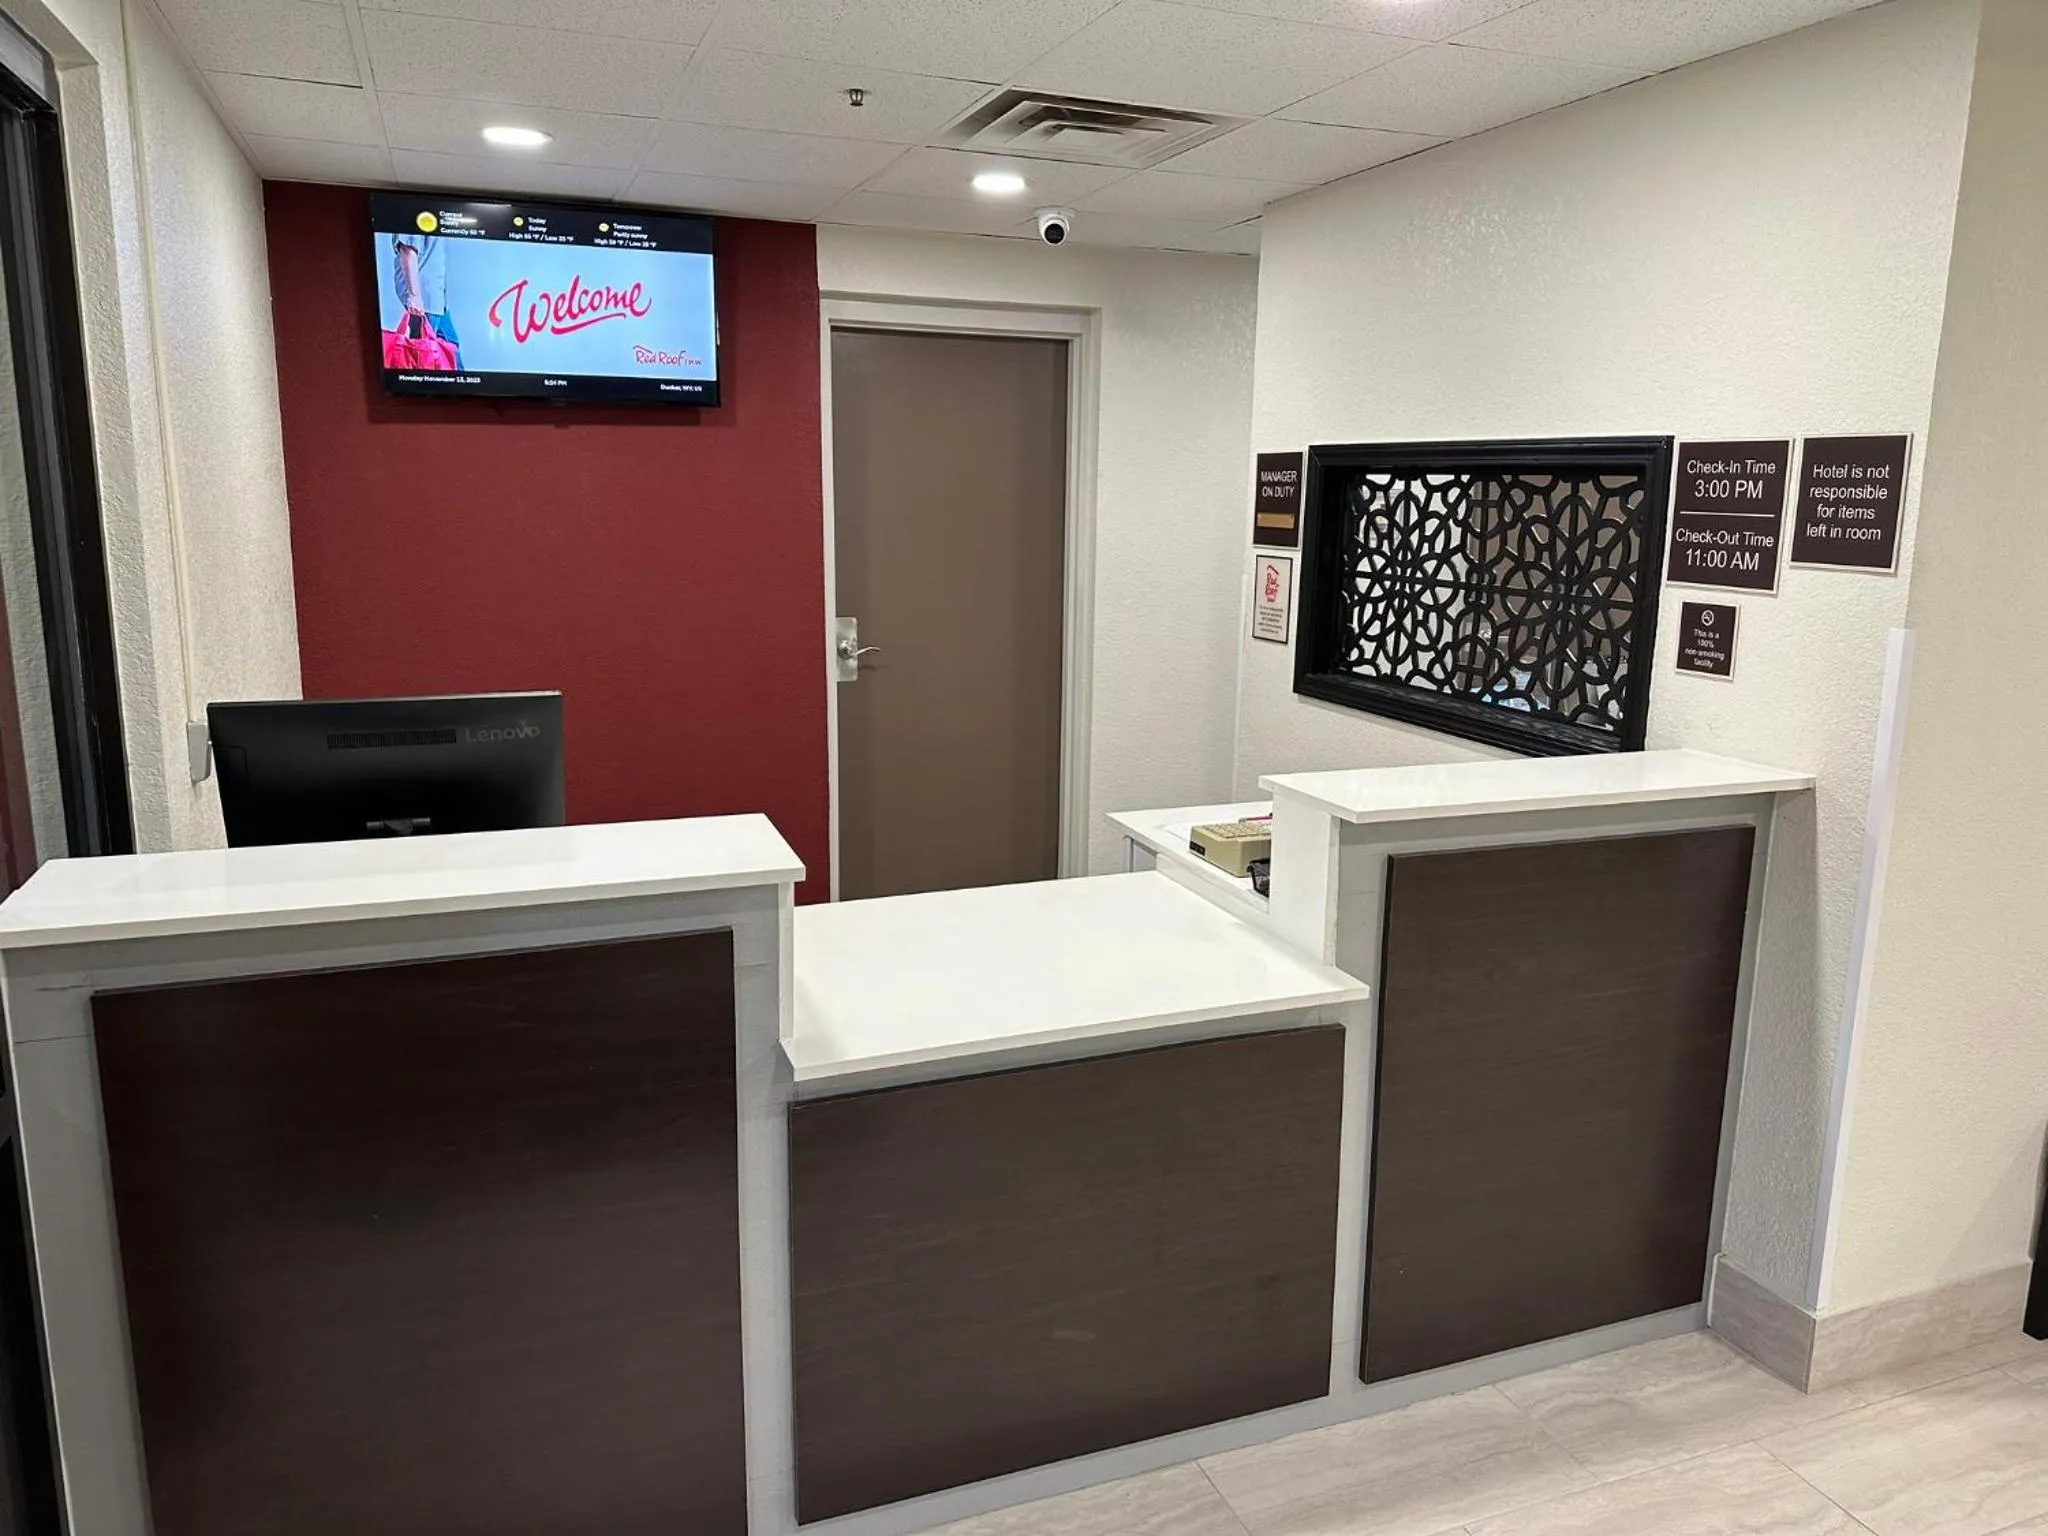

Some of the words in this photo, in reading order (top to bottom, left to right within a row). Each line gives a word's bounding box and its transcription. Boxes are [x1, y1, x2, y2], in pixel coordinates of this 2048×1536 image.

[527, 216, 547, 225] Today
[528, 224, 547, 233] Sunny
[508, 231, 523, 240] High
[488, 273, 652, 343] Welcome
[635, 349, 657, 364] Red
[658, 349, 686, 366] Roof
[398, 375, 424, 384] Monday
[424, 375, 456, 383] November
[1686, 459, 1741, 474] Check-In
[1744, 459, 1776, 475] Time
[1812, 463, 1849, 479] Hotel
[1851, 463, 1864, 479] is
[1867, 464, 1890, 479] not
[1261, 470, 1298, 483] MANAGER
[1262, 485, 1274, 498] ON
[1274, 486, 1296, 498] DUTY
[1694, 479, 1730, 498] 3:00
[1735, 480, 1764, 499] PM
[1809, 484, 1888, 501] responsible
[1816, 503, 1836, 519] for
[1838, 504, 1876, 520] items
[1675, 527, 1740, 546] Check-Out
[1743, 531, 1775, 547] Time
[1806, 522, 1827, 538] left
[1830, 523, 1842, 538] in
[1845, 527, 1881, 540] room
[1685, 548, 1727, 568] 11:00
[1729, 550, 1760, 571] AM
[465, 719, 541, 743] Lenovo
